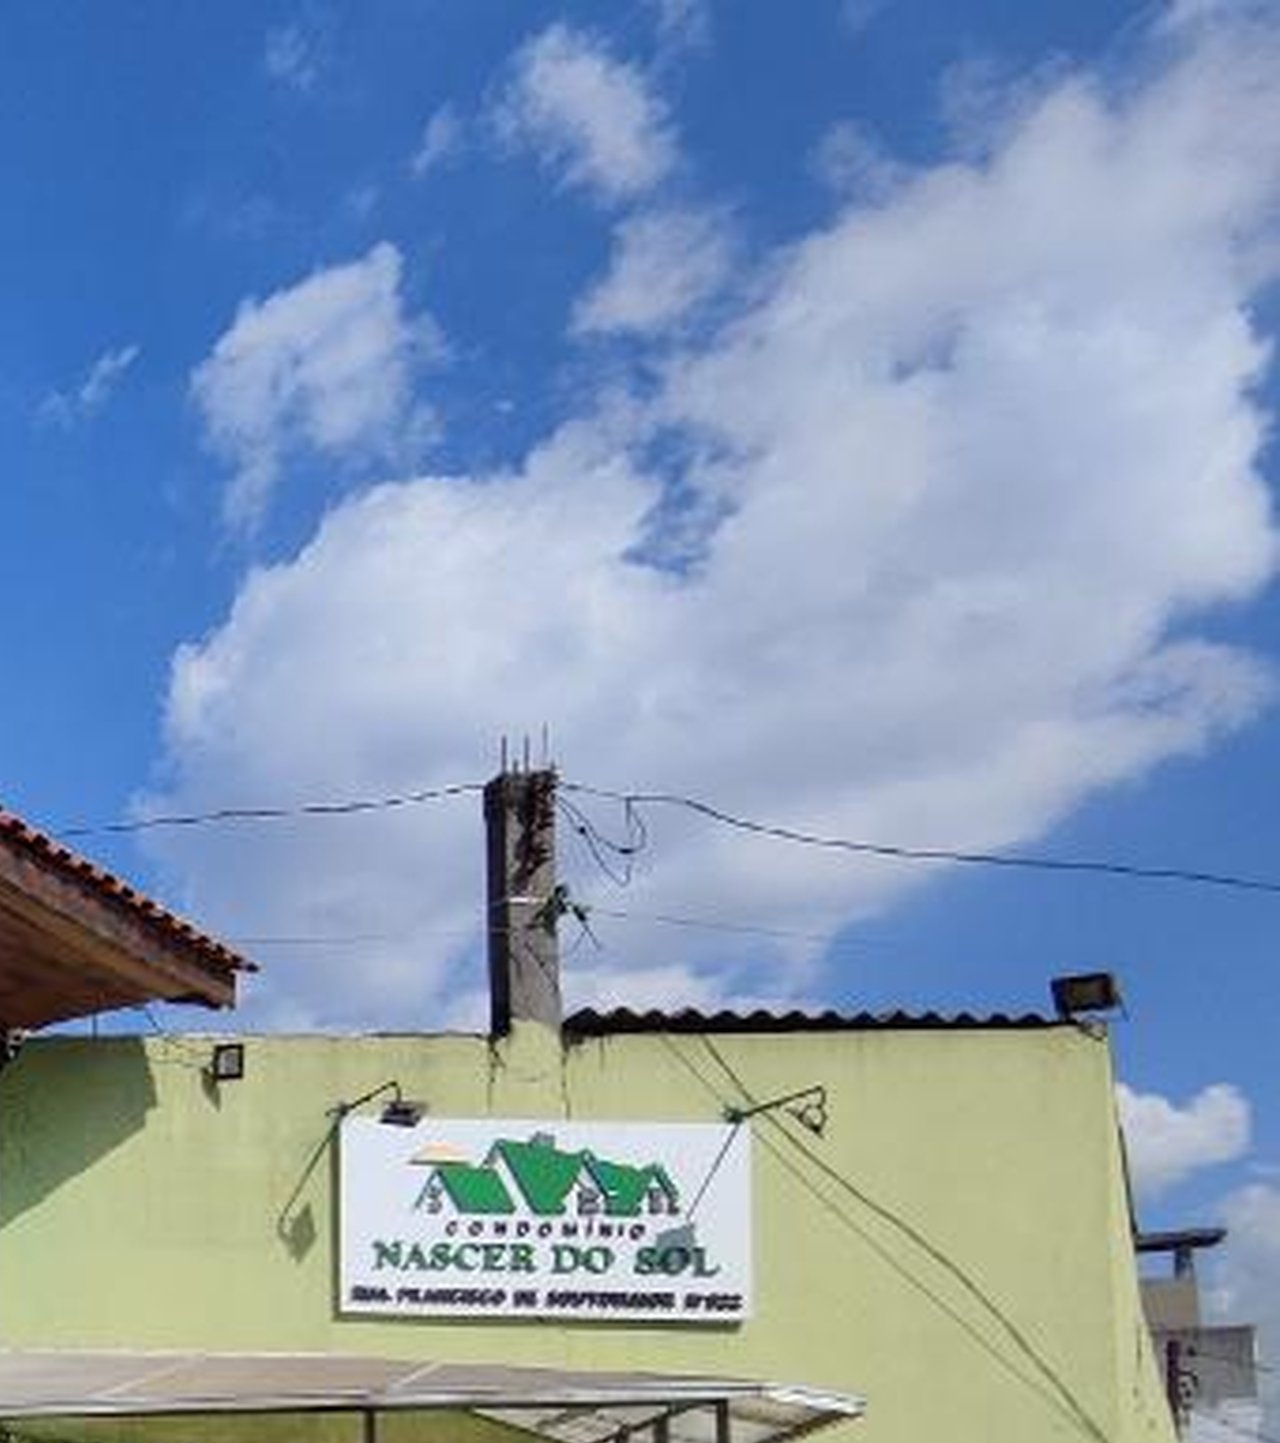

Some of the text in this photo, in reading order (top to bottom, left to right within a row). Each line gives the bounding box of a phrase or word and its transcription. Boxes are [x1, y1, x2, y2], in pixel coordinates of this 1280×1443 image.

[445, 1218, 646, 1240] CONDOMÍNIO
[372, 1241, 719, 1278] NASCER DO SOL
